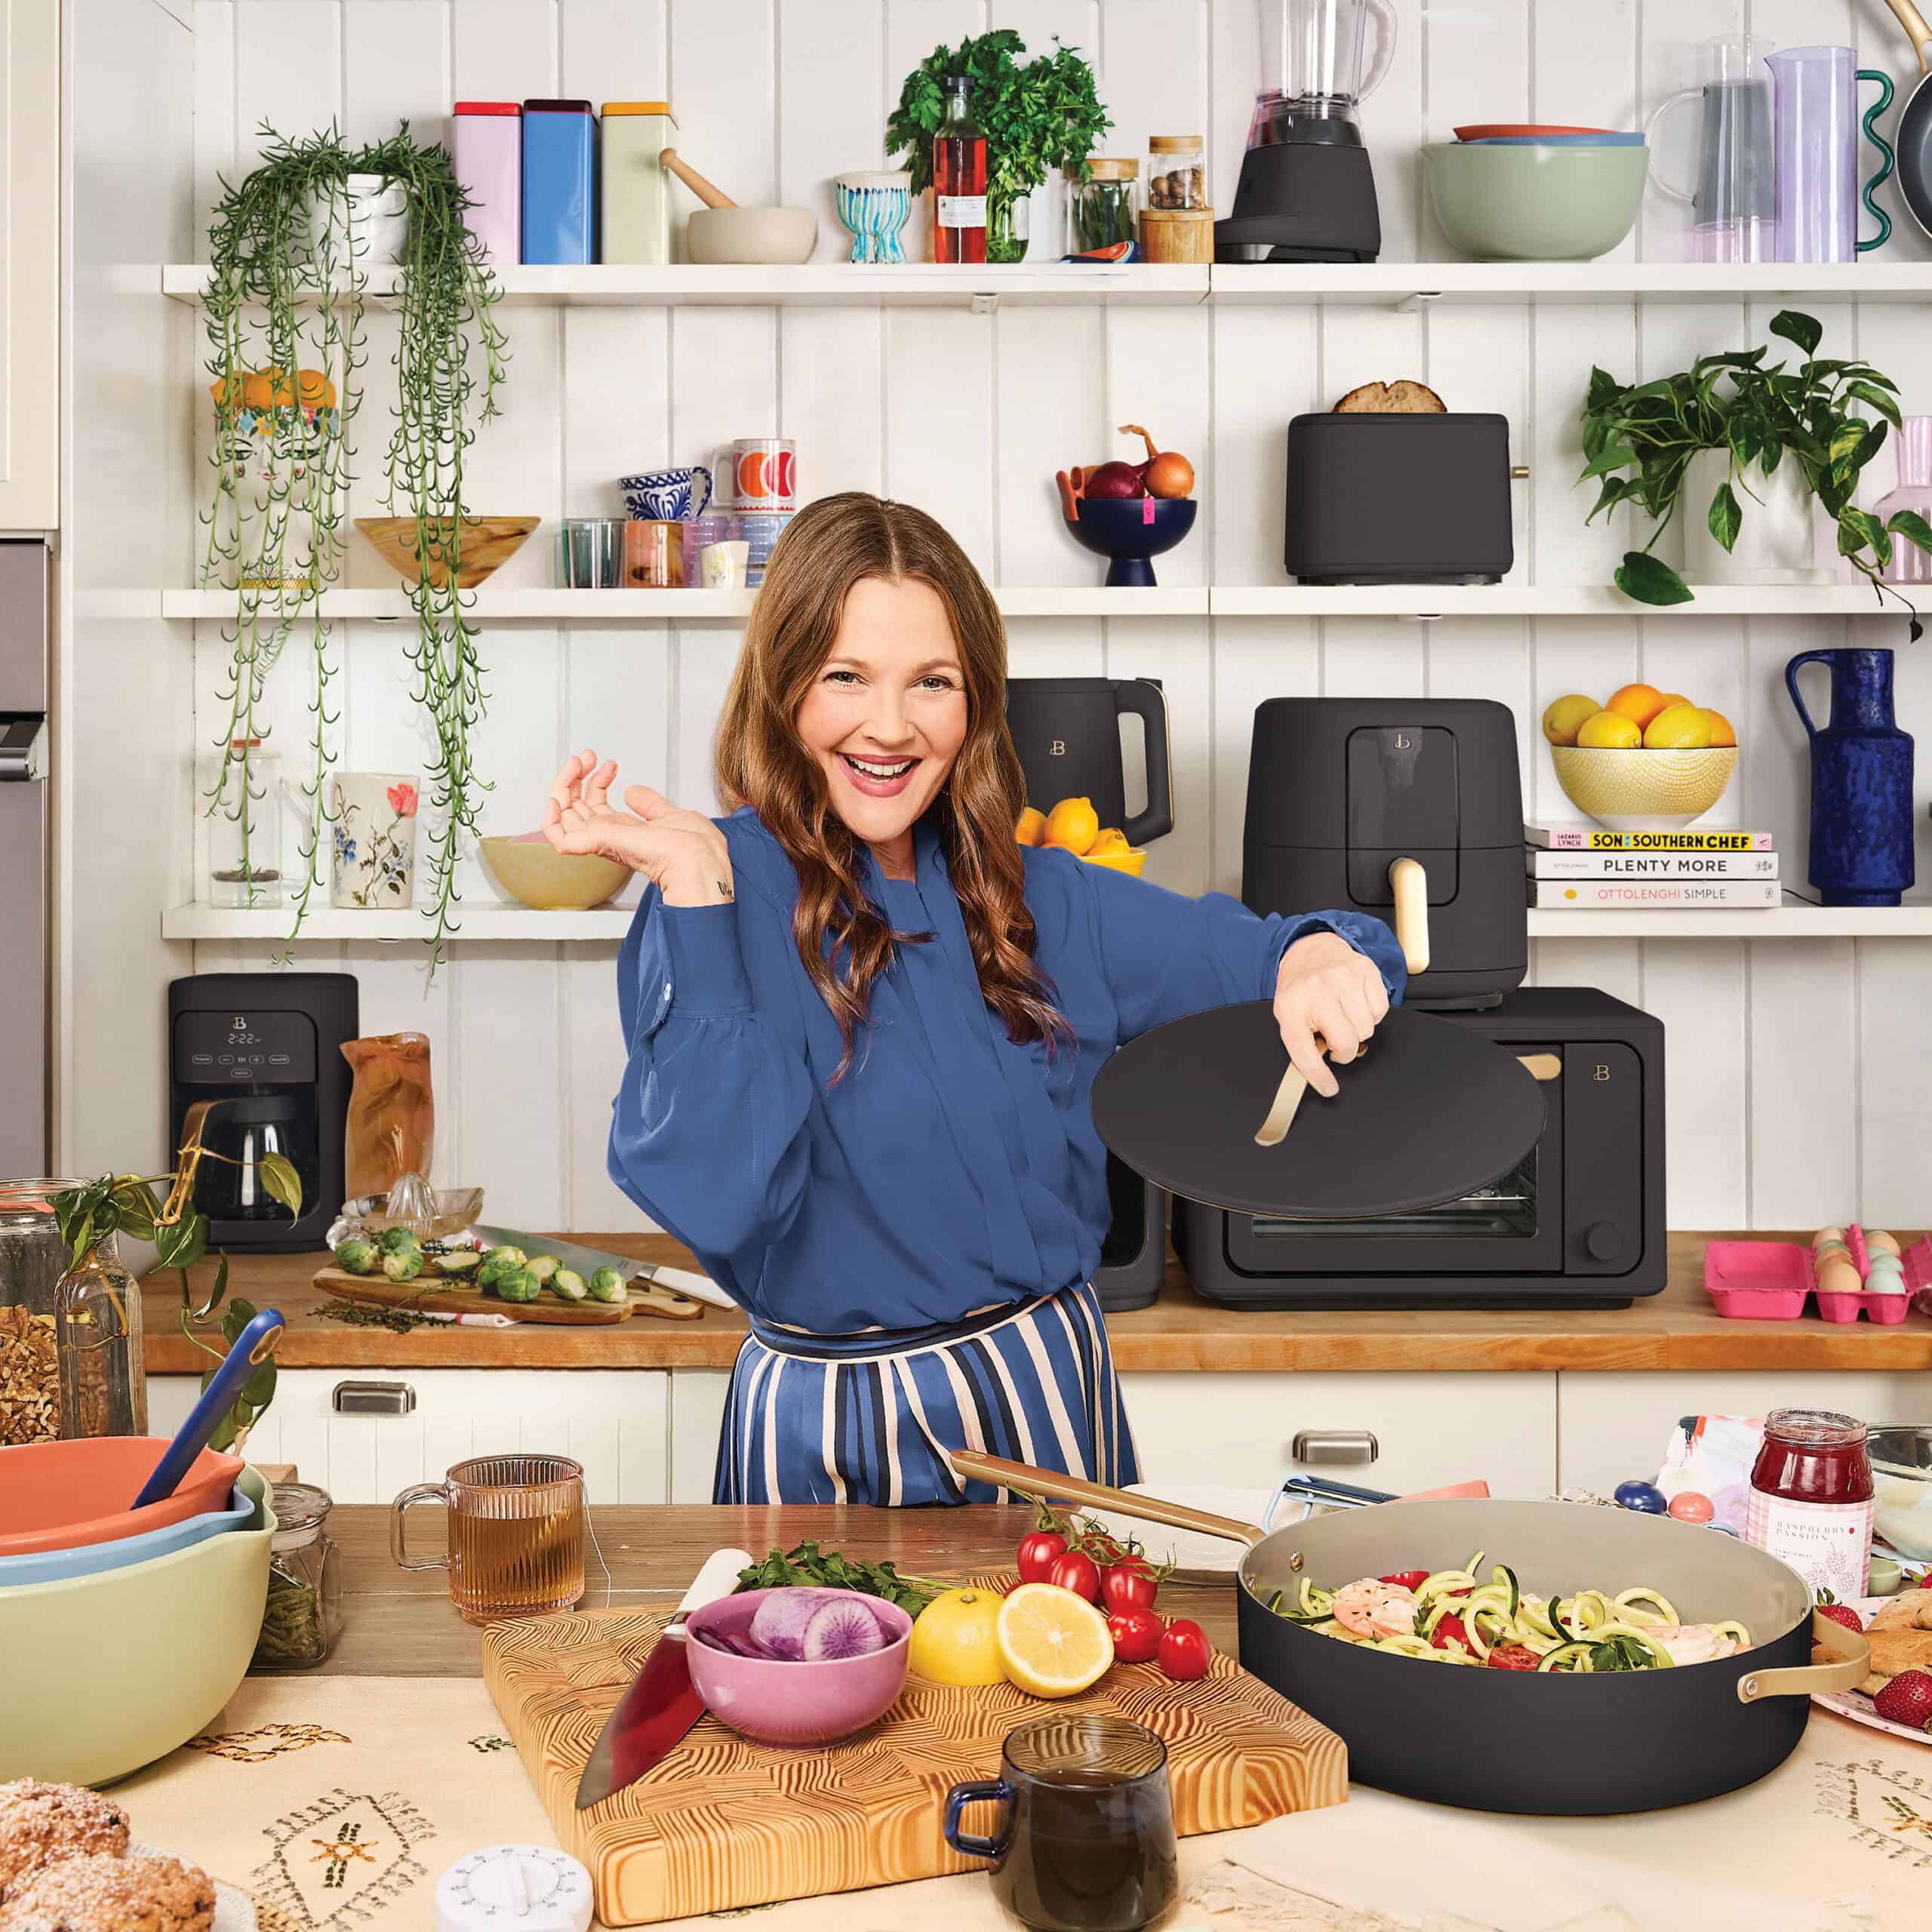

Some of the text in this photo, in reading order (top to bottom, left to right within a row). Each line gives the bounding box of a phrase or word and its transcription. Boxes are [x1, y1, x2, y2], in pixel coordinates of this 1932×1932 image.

[1050, 740, 1065, 755] B
[1593, 834, 1623, 847] SON
[1633, 834, 1703, 848] SOUTHERN
[1706, 835, 1749, 848] CHEF
[1604, 860, 1727, 872] PLENTY MORE
[1598, 889, 1727, 900] OTTOLENGHI SIMPLE
[232, 1016, 247, 1029] B
[228, 1033, 254, 1044] 2:22
[1593, 1065, 1610, 1081] B
[1776, 1520, 1846, 1534] RASPBERRY
[1776, 1528, 1827, 1540] PASSION
